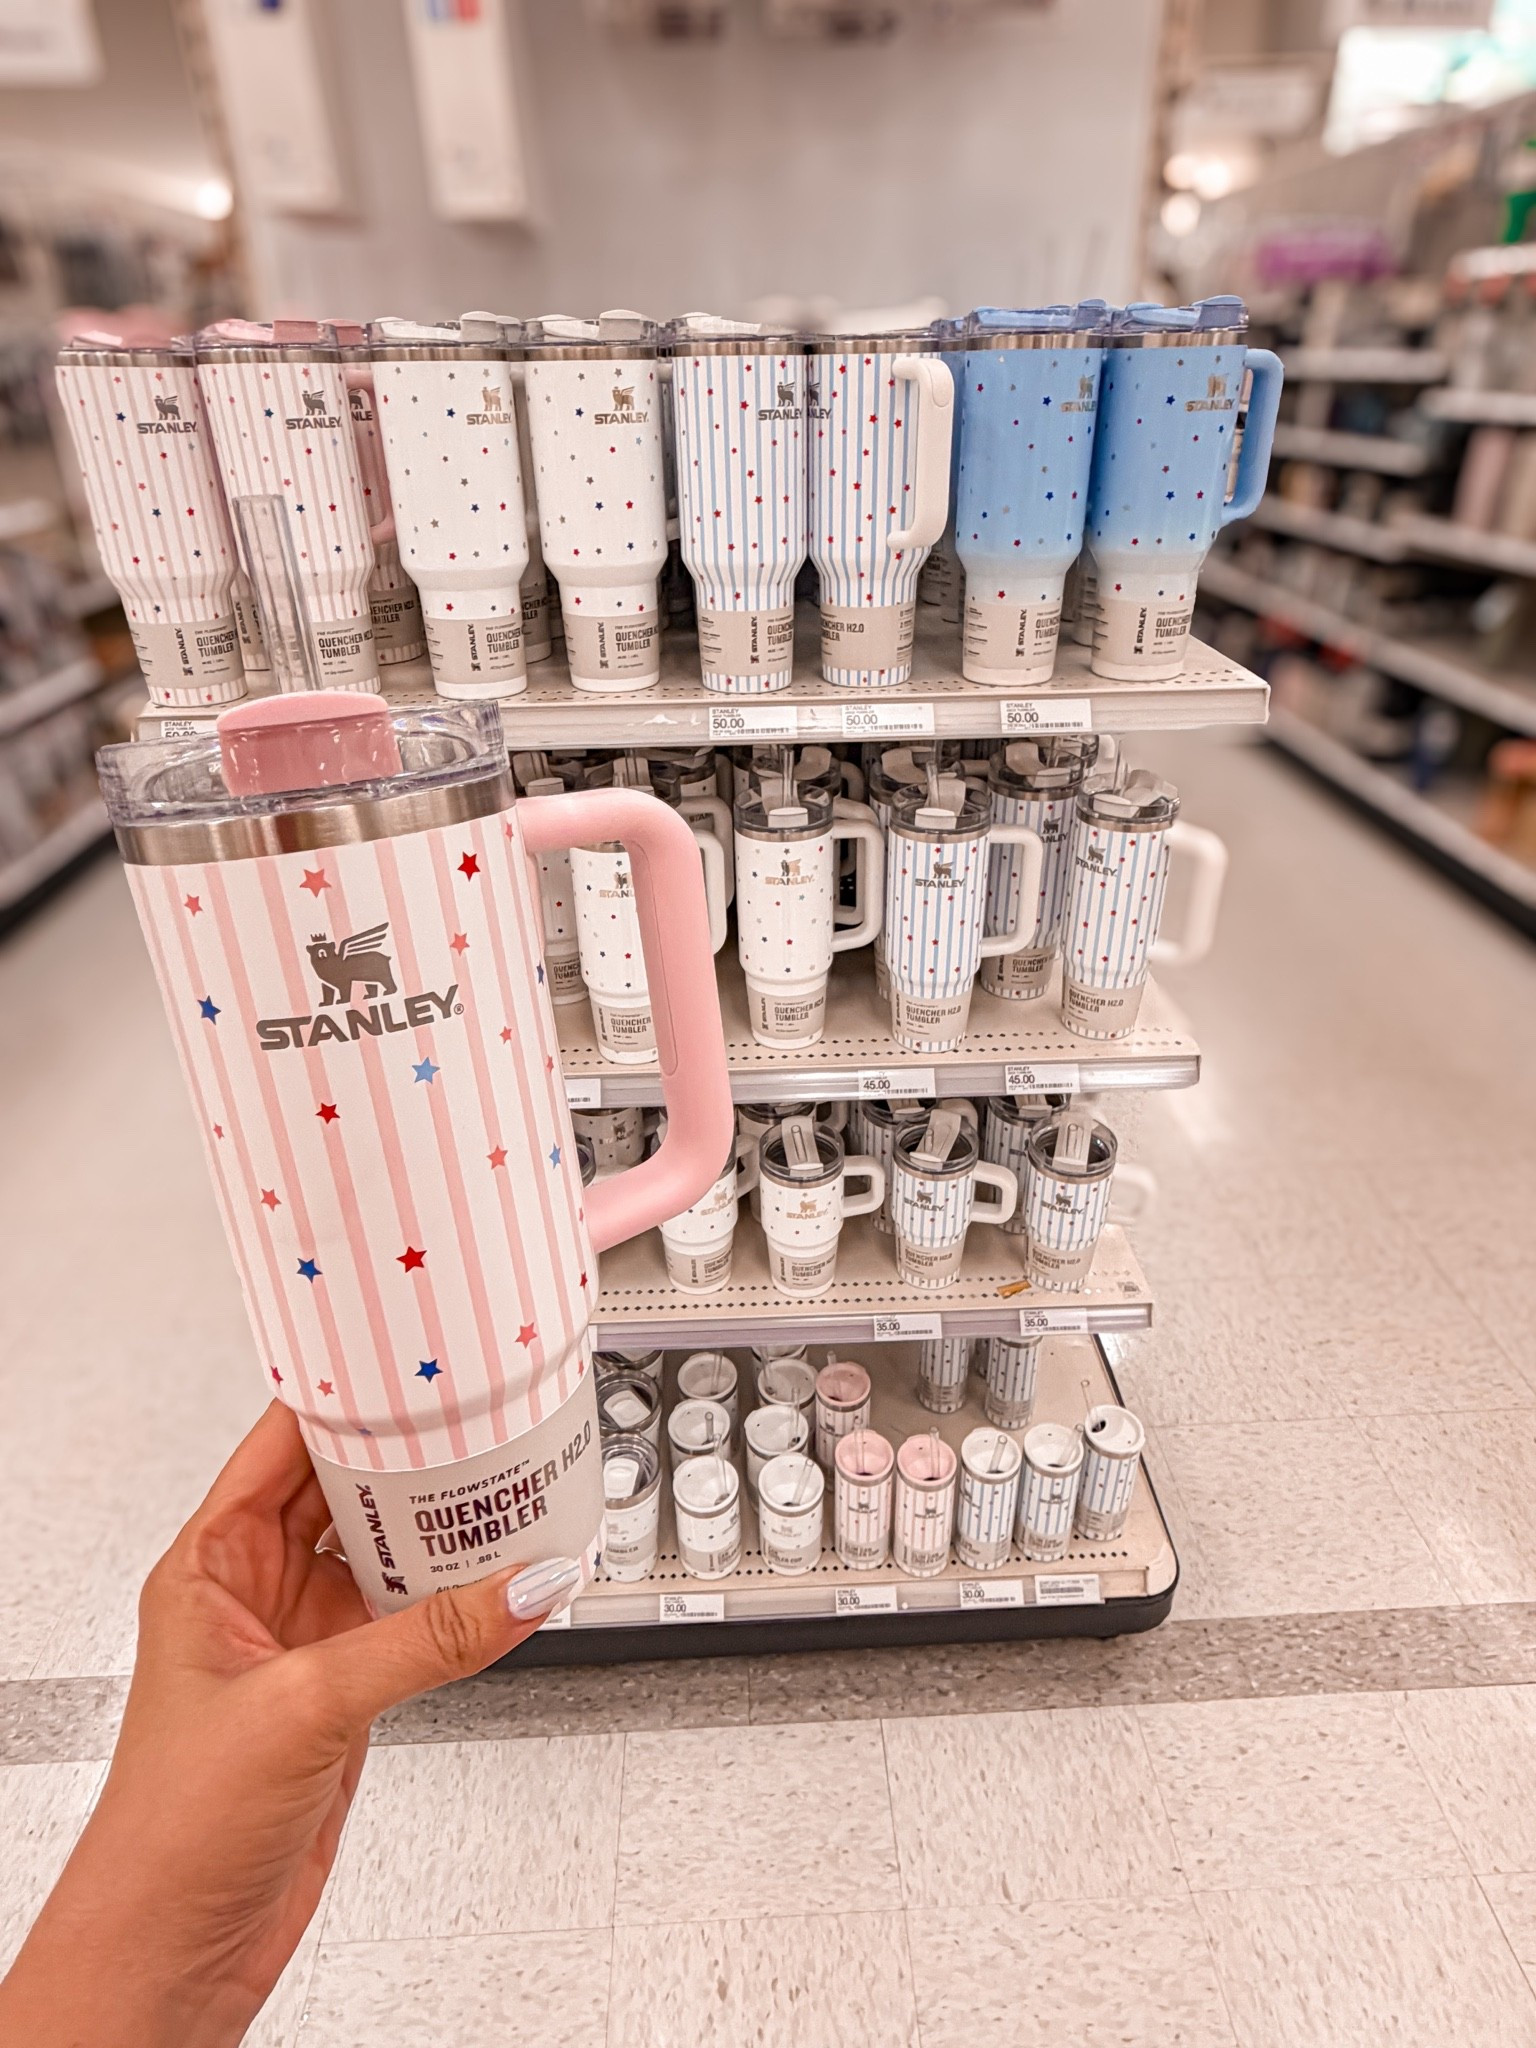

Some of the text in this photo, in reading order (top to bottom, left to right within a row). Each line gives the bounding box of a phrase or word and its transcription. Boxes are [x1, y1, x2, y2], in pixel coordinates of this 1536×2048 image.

[1060, 401, 1096, 412] STANLE
[285, 416, 342, 430] STANLEY
[594, 412, 648, 425] STANLEY
[136, 421, 198, 434] STANLEY
[846, 622, 864, 634] H2.0
[320, 645, 360, 659] TUMBLER
[713, 718, 745, 729] 50.00
[846, 714, 878, 726] 50.00
[1007, 712, 1040, 723] 50.00
[1041, 832, 1069, 844] ANLEY
[1075, 856, 1118, 877] STANLEY
[765, 875, 815, 886] STANLEY
[915, 878, 966, 889] STANLEY
[863, 1080, 891, 1090] 45.00
[1008, 1074, 1035, 1084] 45.00
[877, 1322, 901, 1331] 35.00
[1024, 1318, 1048, 1327] 35.00
[414, 1419, 591, 1533] QUENCHER H2.0
[409, 1493, 436, 1505] THE
[356, 1483, 397, 1571] STANLEY
[419, 1494, 549, 1557] TUMBLER
[430, 1565, 444, 1574] 30
[445, 1562, 460, 1573] OZ
[494, 1551, 502, 1559] L
[962, 1590, 985, 1598] 30.00
[838, 1597, 860, 1605] 30.00
[664, 1604, 686, 1612] 30.00
